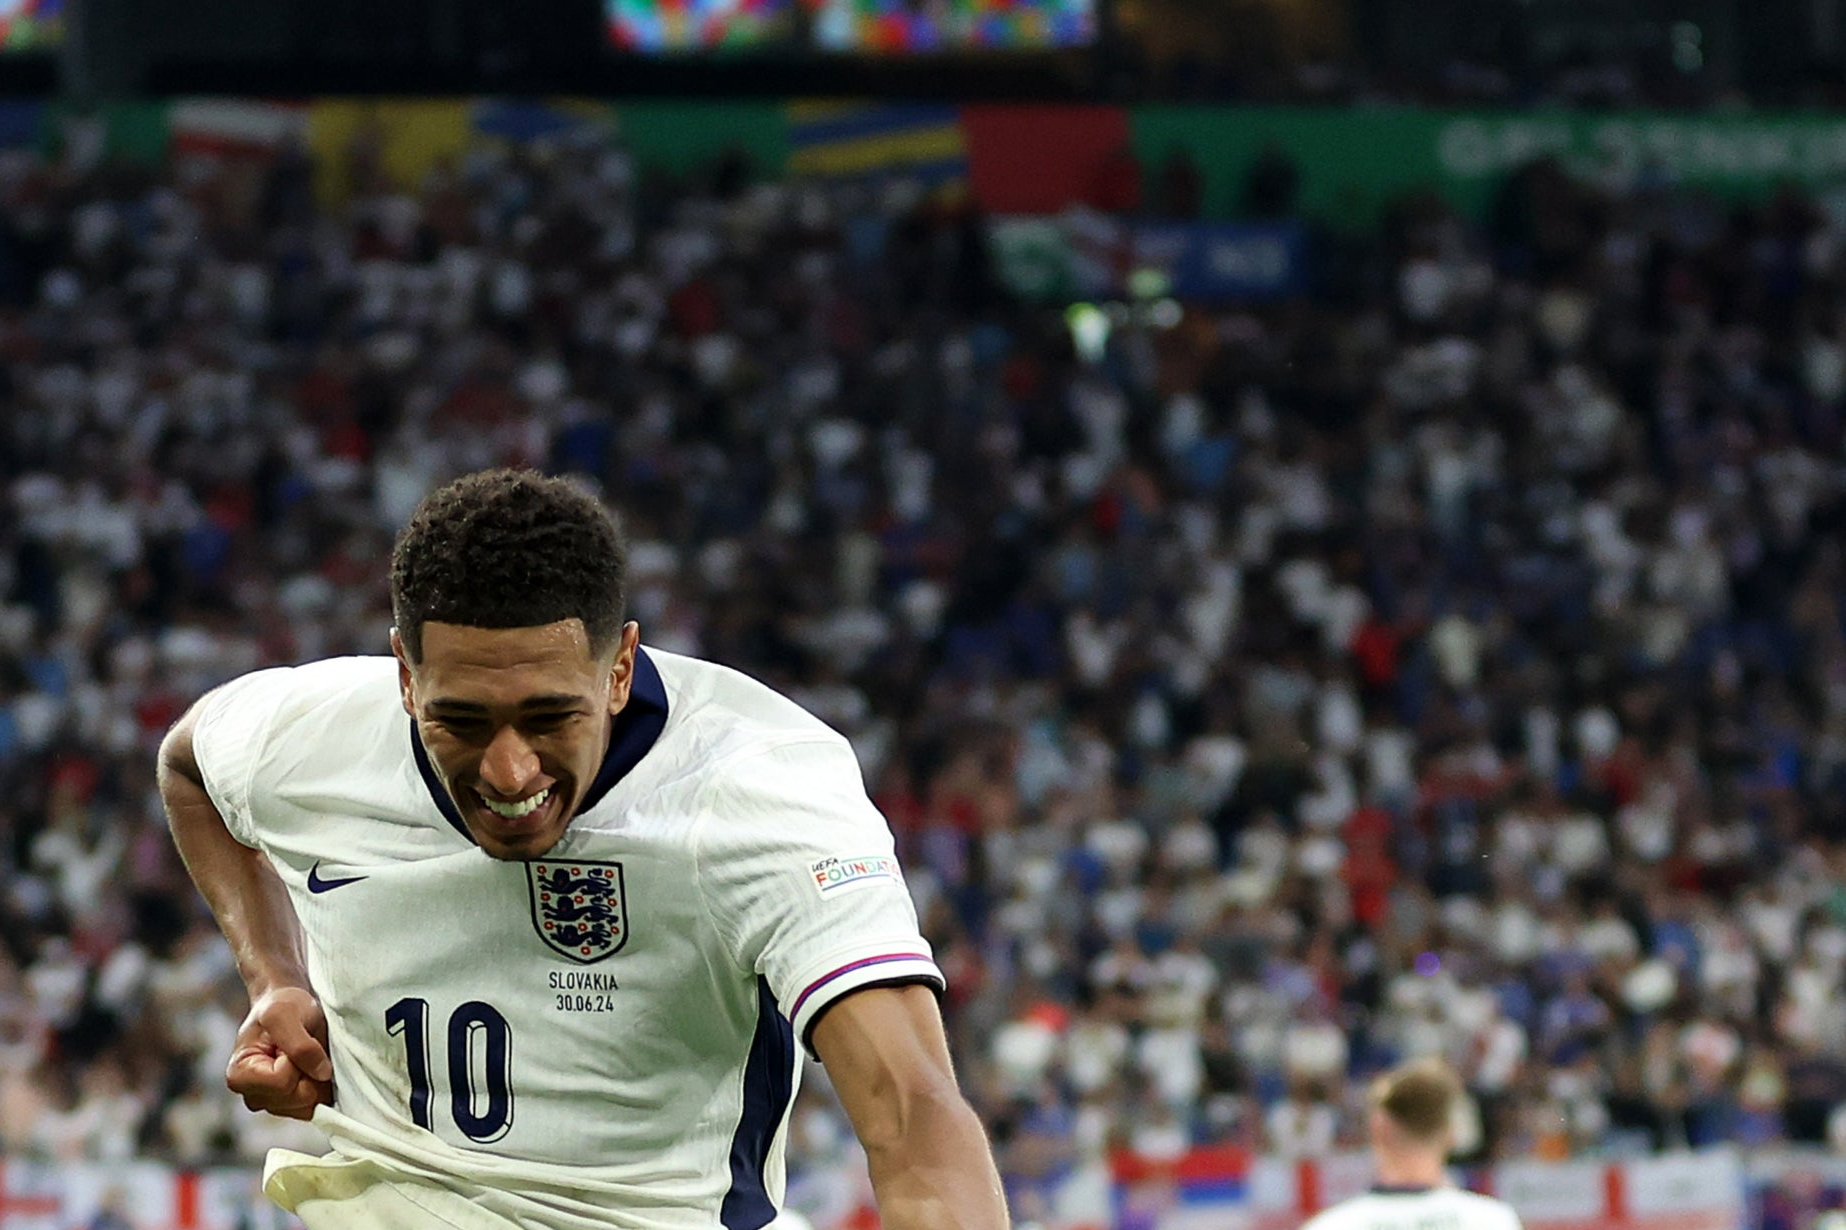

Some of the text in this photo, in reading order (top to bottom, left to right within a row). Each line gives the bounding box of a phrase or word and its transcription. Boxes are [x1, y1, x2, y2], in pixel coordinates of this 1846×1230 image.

[811, 857, 840, 873] UEFA
[549, 971, 619, 991] SLOVAKIA
[556, 994, 615, 1013] 30.06.24
[385, 997, 515, 1145] 10
